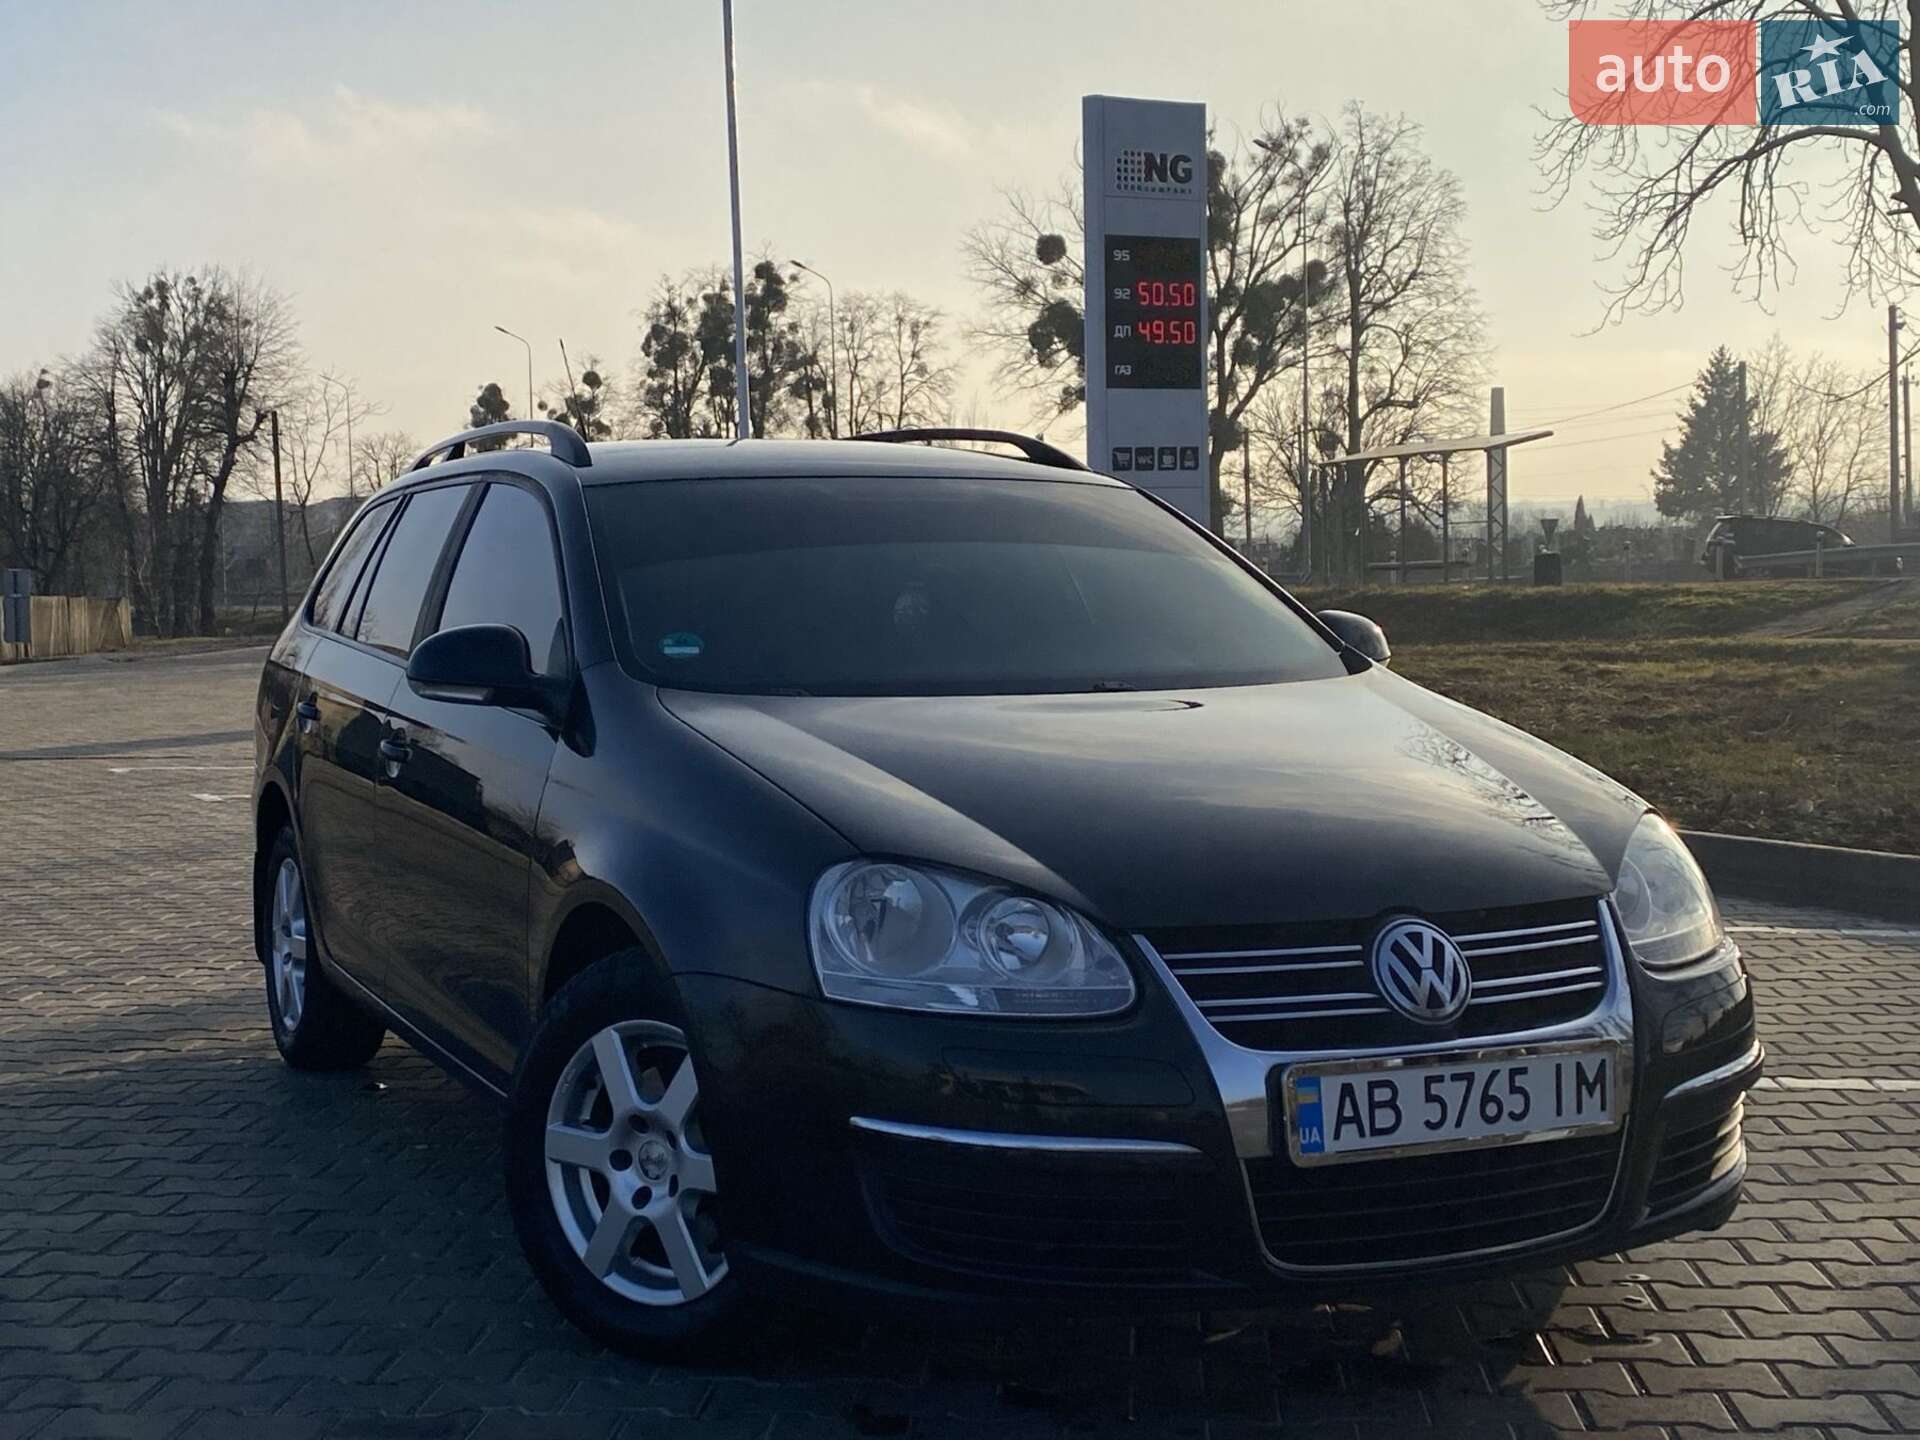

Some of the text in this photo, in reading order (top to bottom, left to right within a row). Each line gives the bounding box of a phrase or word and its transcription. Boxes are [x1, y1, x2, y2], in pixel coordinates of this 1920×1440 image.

[1113, 249, 1130, 261] 95
[1114, 281, 1195, 307] 92 50.50
[1114, 320, 1195, 344] ДП 49.50
[1114, 364, 1132, 375] ГАЗ
[1333, 1059, 1607, 1141] AB 5765 IM
[1299, 1126, 1322, 1145] UA
